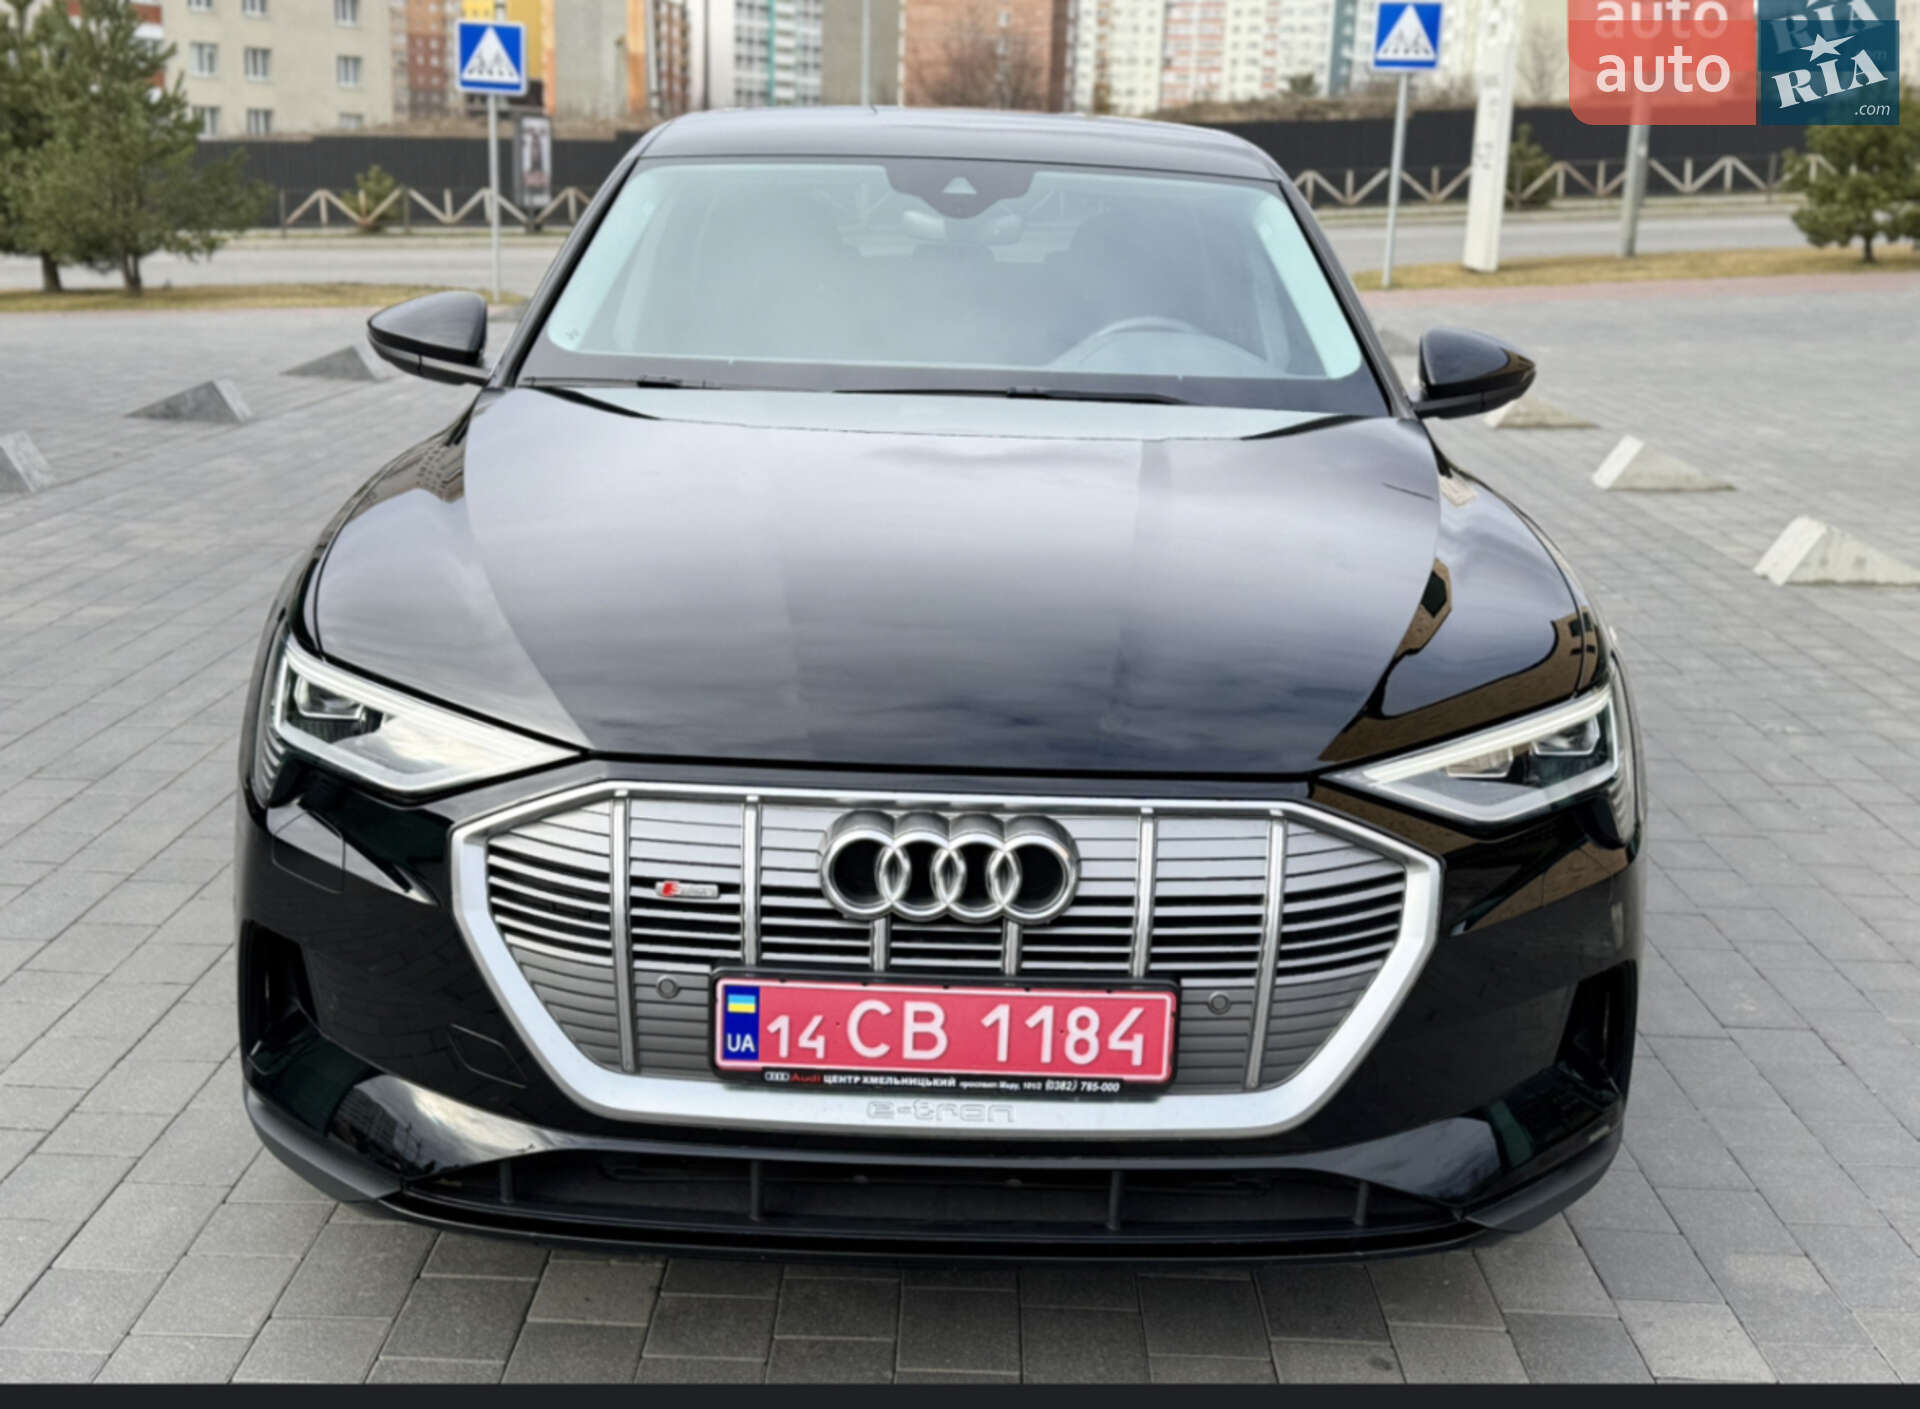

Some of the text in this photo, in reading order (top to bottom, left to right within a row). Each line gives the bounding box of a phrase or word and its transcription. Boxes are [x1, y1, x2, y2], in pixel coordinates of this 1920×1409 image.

[726, 1033, 756, 1053] UA
[767, 999, 1145, 1067] 14 CB 1184
[791, 1072, 821, 1083] Audi
[823, 1073, 861, 1085] ЦЕНТР
[862, 1074, 956, 1088] ХМЕЛЬНИЦЬКИЙ
